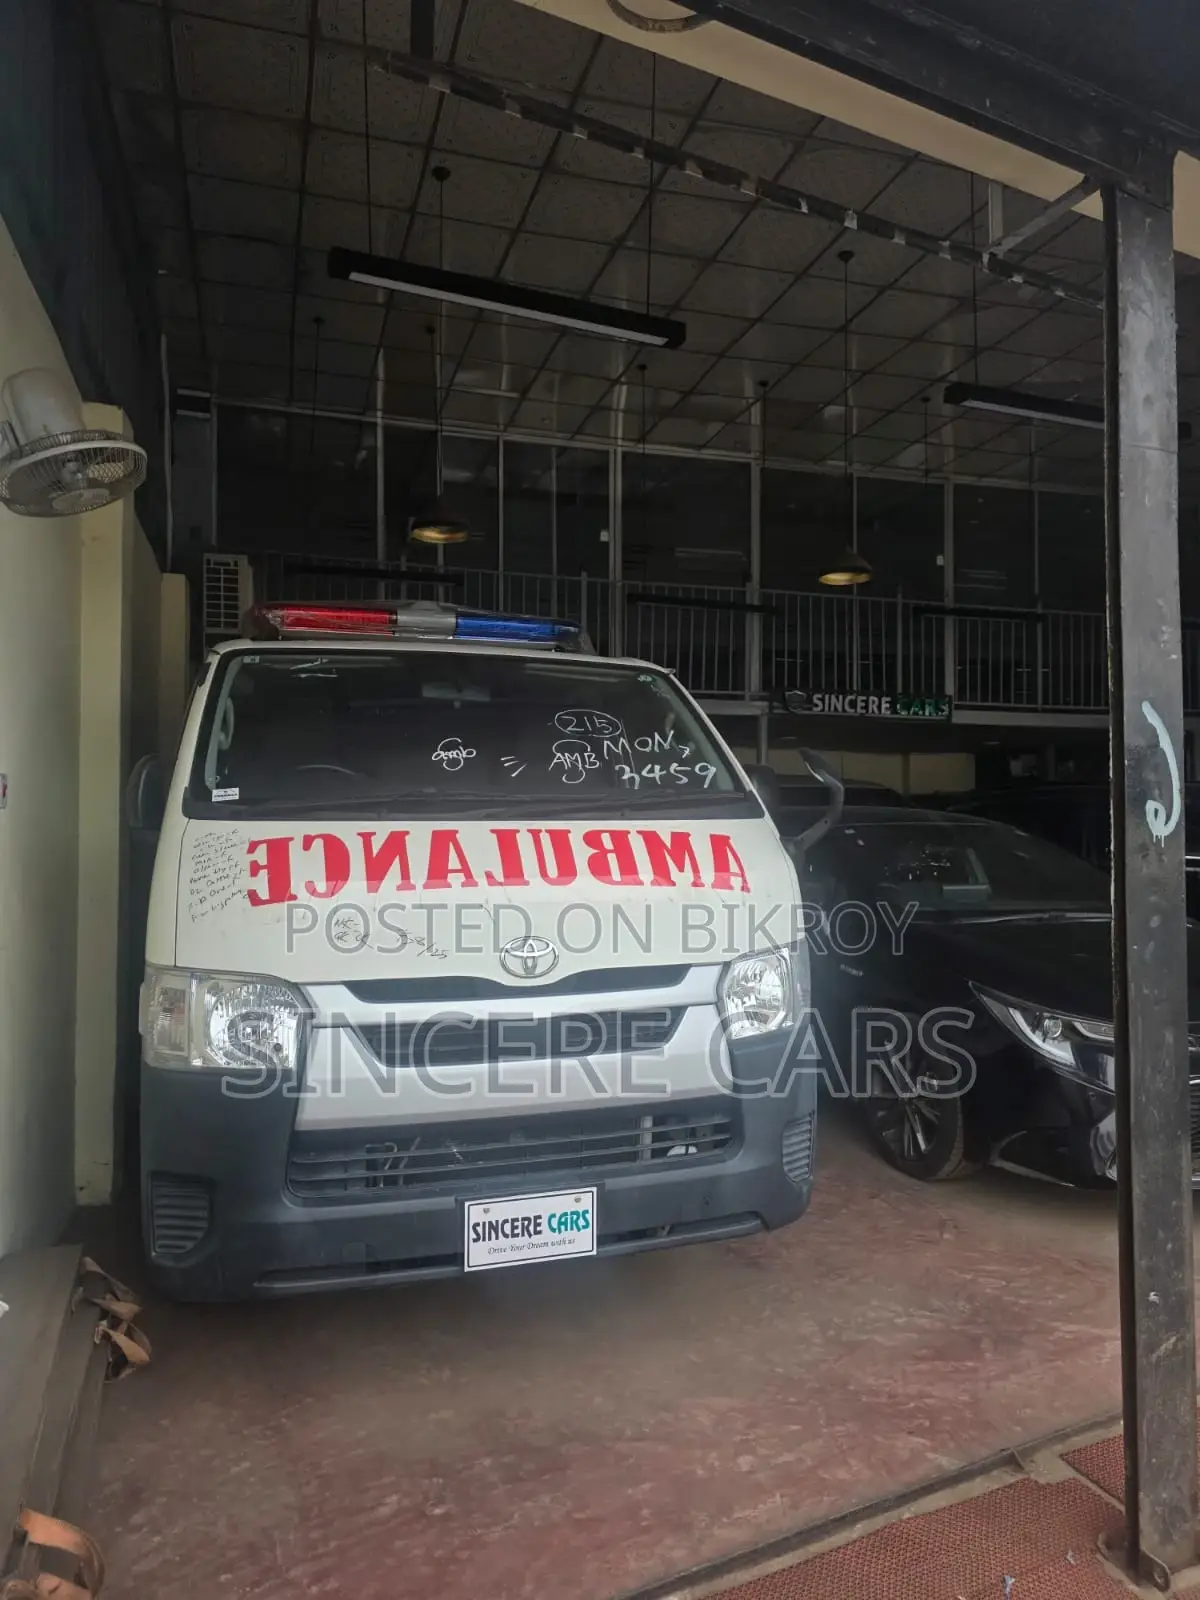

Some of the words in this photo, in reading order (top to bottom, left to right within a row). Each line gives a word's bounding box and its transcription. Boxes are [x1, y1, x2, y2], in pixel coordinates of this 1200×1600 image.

[811, 693, 892, 715] SINCERE
[896, 697, 949, 717] CARS
[560, 714, 612, 734] 215
[471, 1214, 543, 1244] SINCERE
[547, 1208, 590, 1235] CARS
[487, 1246, 507, 1256] Drive
[526, 1241, 549, 1250] Dream
[550, 1237, 567, 1247] with
